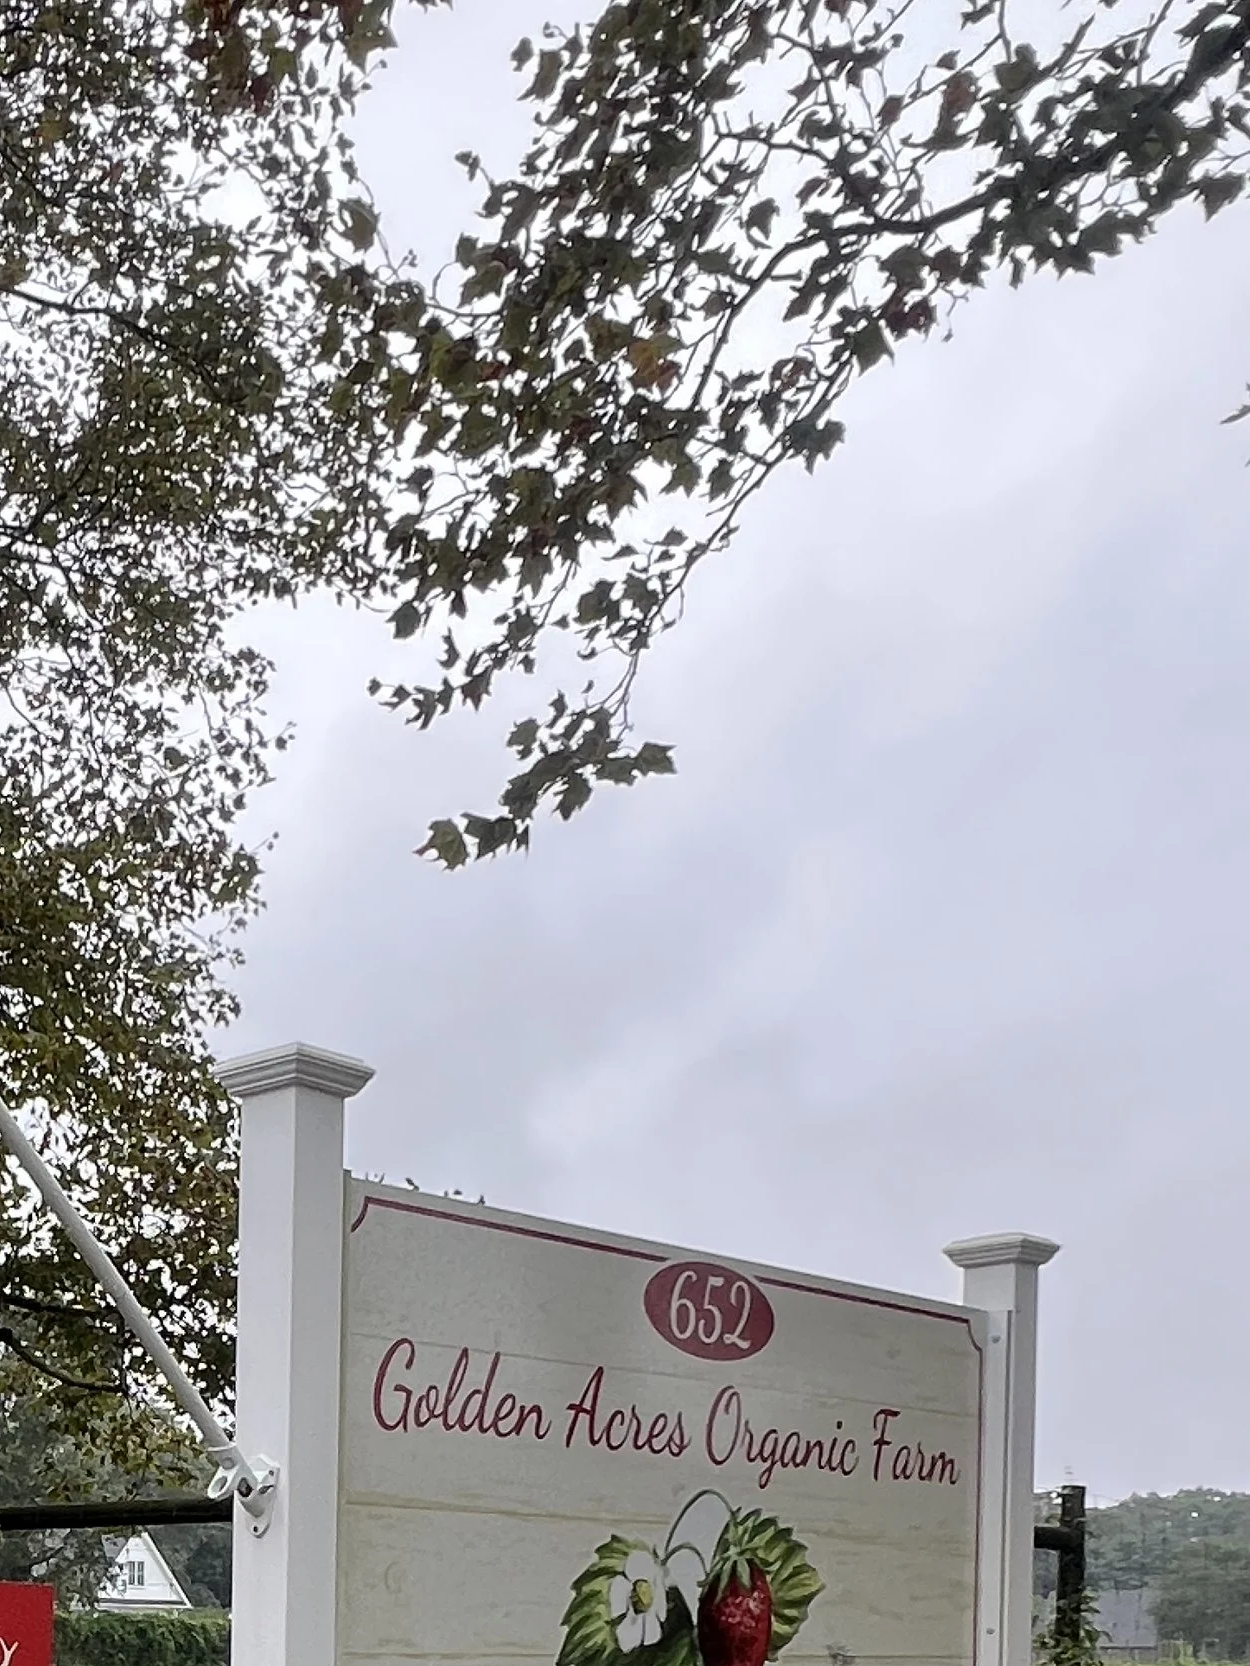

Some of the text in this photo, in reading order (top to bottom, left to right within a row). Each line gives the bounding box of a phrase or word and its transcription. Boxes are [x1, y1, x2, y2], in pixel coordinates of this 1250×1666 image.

[669, 1270, 751, 1349] 652
[373, 1337, 960, 1489] Golden Acres Organic Farm
